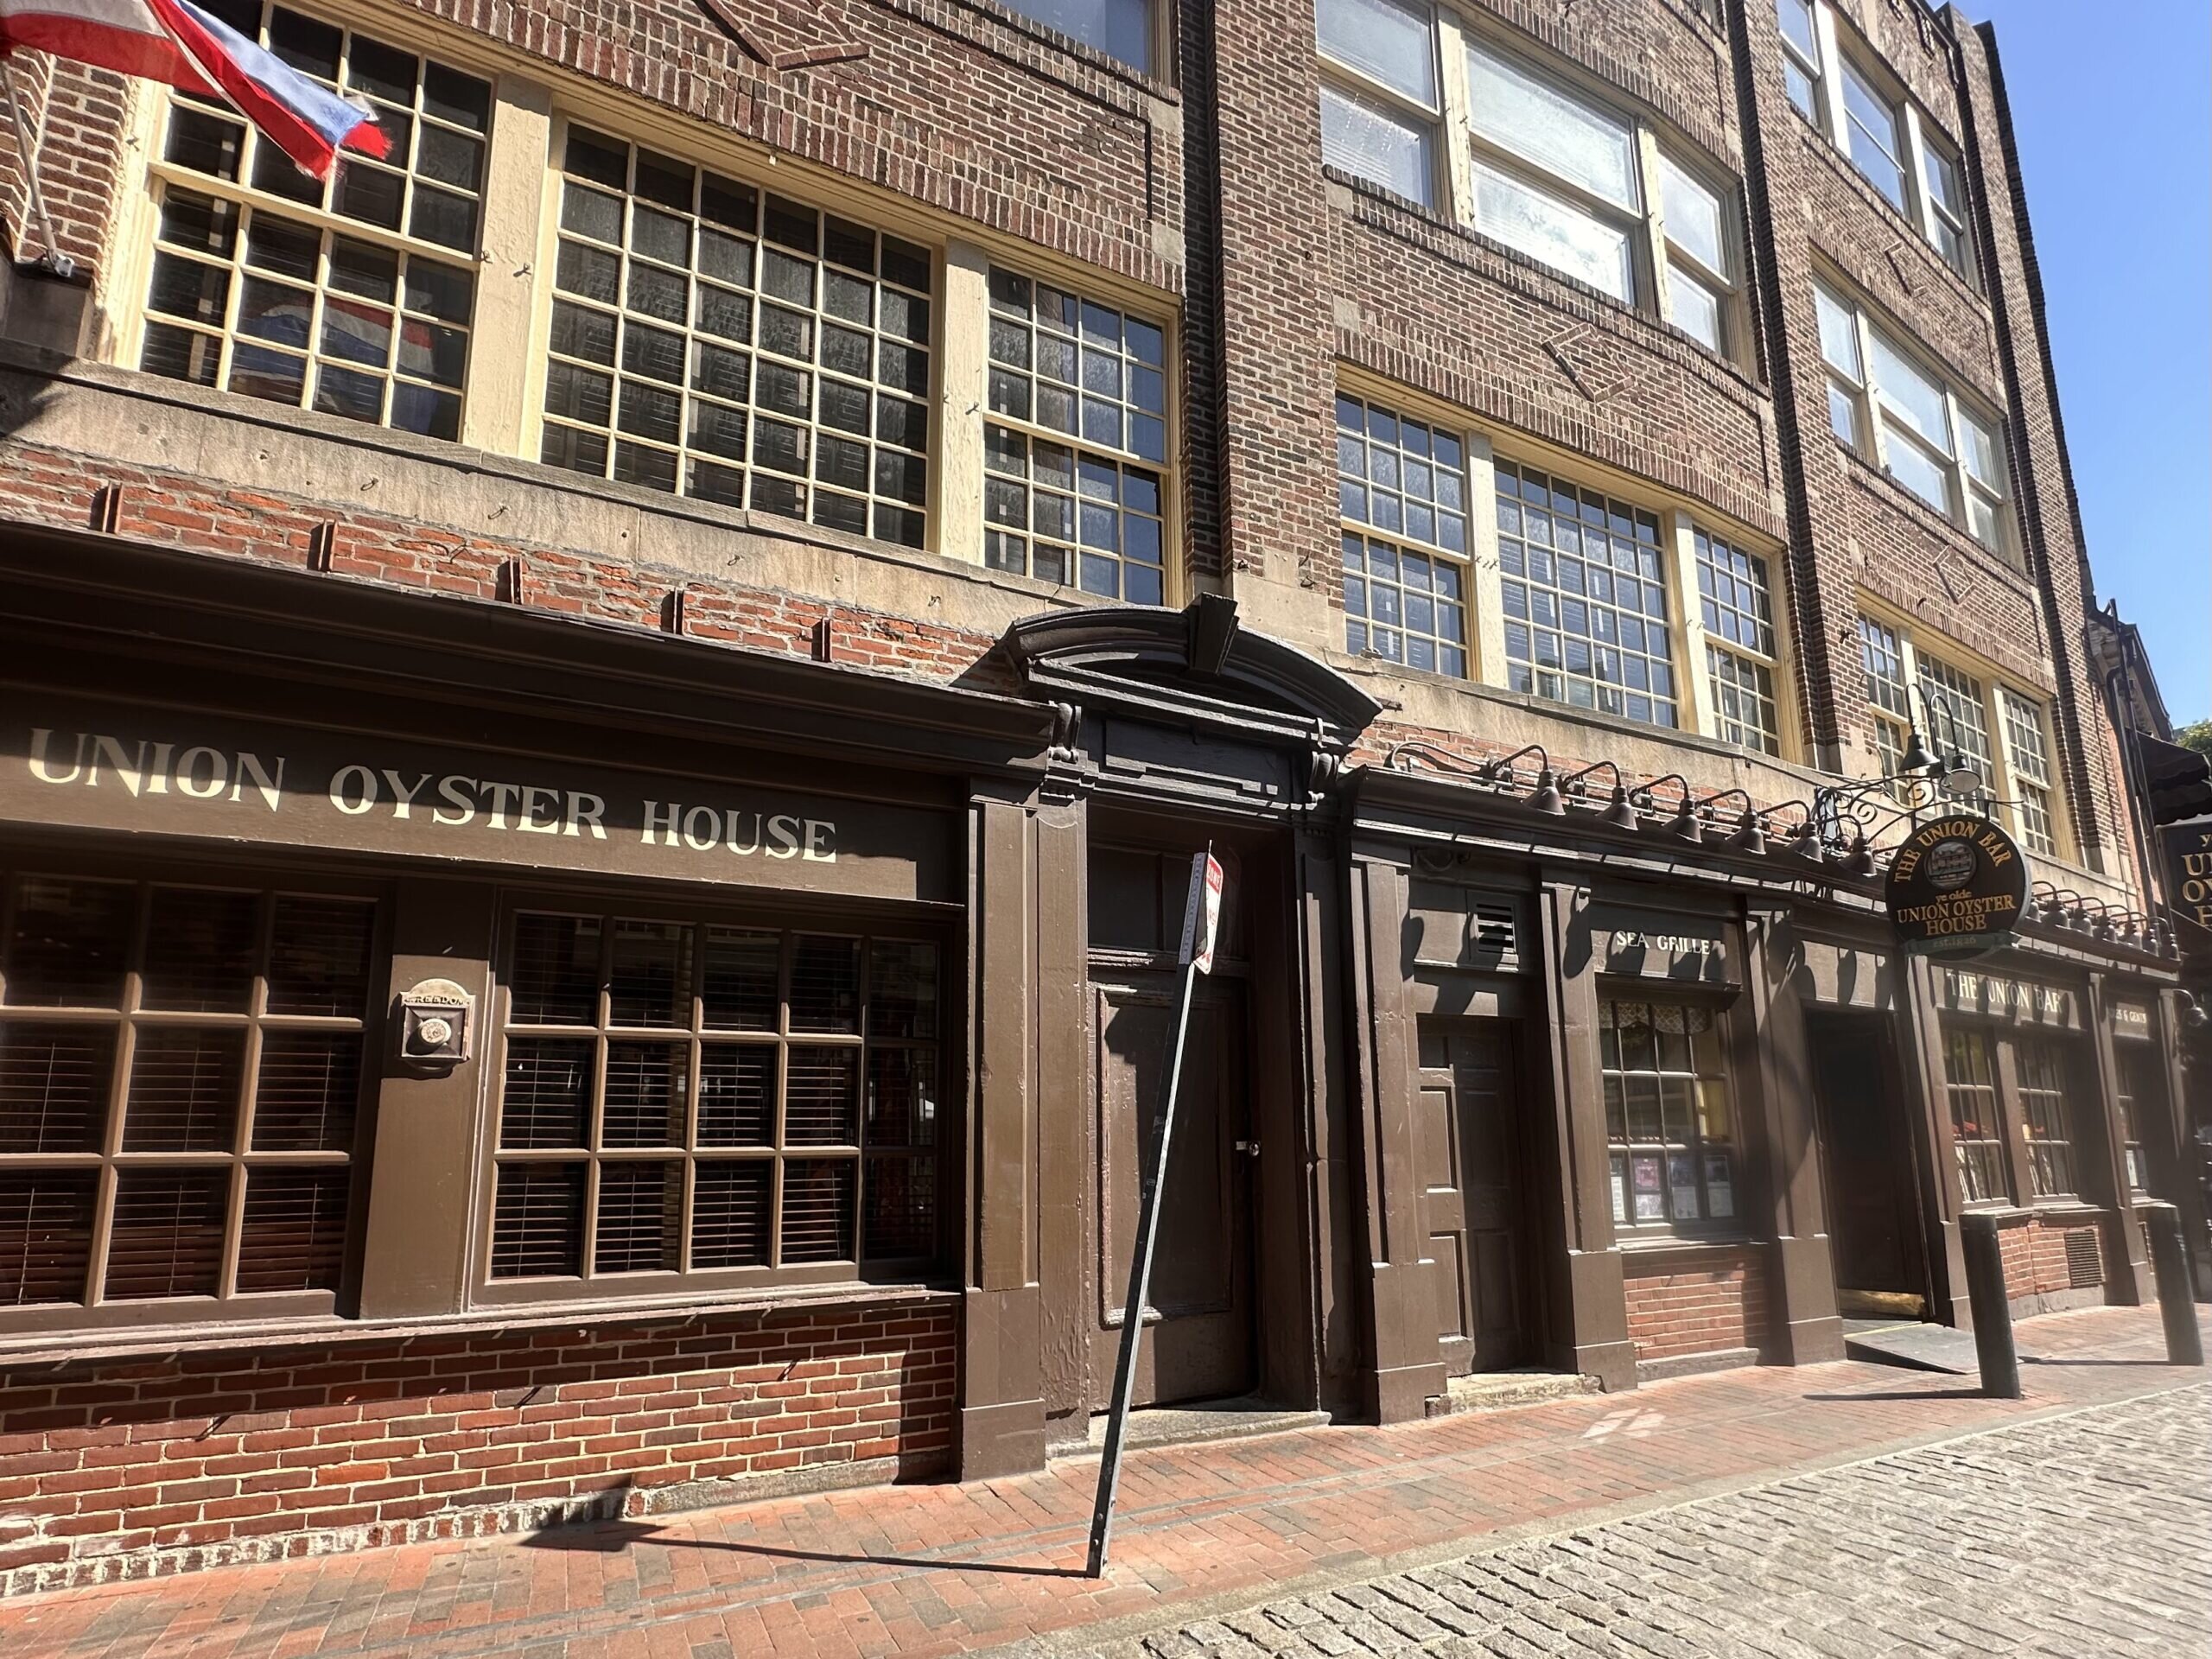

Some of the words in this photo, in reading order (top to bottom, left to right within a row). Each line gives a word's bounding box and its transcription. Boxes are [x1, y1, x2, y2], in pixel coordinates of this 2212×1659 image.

[29, 728, 284, 812] UNION
[330, 765, 607, 840] OYSTER
[640, 800, 836, 863] HOUSE
[1894, 848, 1921, 882] THE
[1917, 820, 1980, 847] UNION
[1979, 831, 2012, 867] BAR
[1897, 902, 1949, 923] UNION
[1954, 895, 2016, 916] OYSTER
[1936, 893, 1947, 905] ye
[1948, 890, 1973, 900] olde
[1926, 914, 1986, 936] HOUSE
[1616, 930, 1649, 949] SEA
[1656, 935, 1711, 955] GRILLE
[1947, 972, 1978, 999] THE
[1986, 980, 2029, 1009] UNION
[2034, 988, 2062, 1013] BAR
